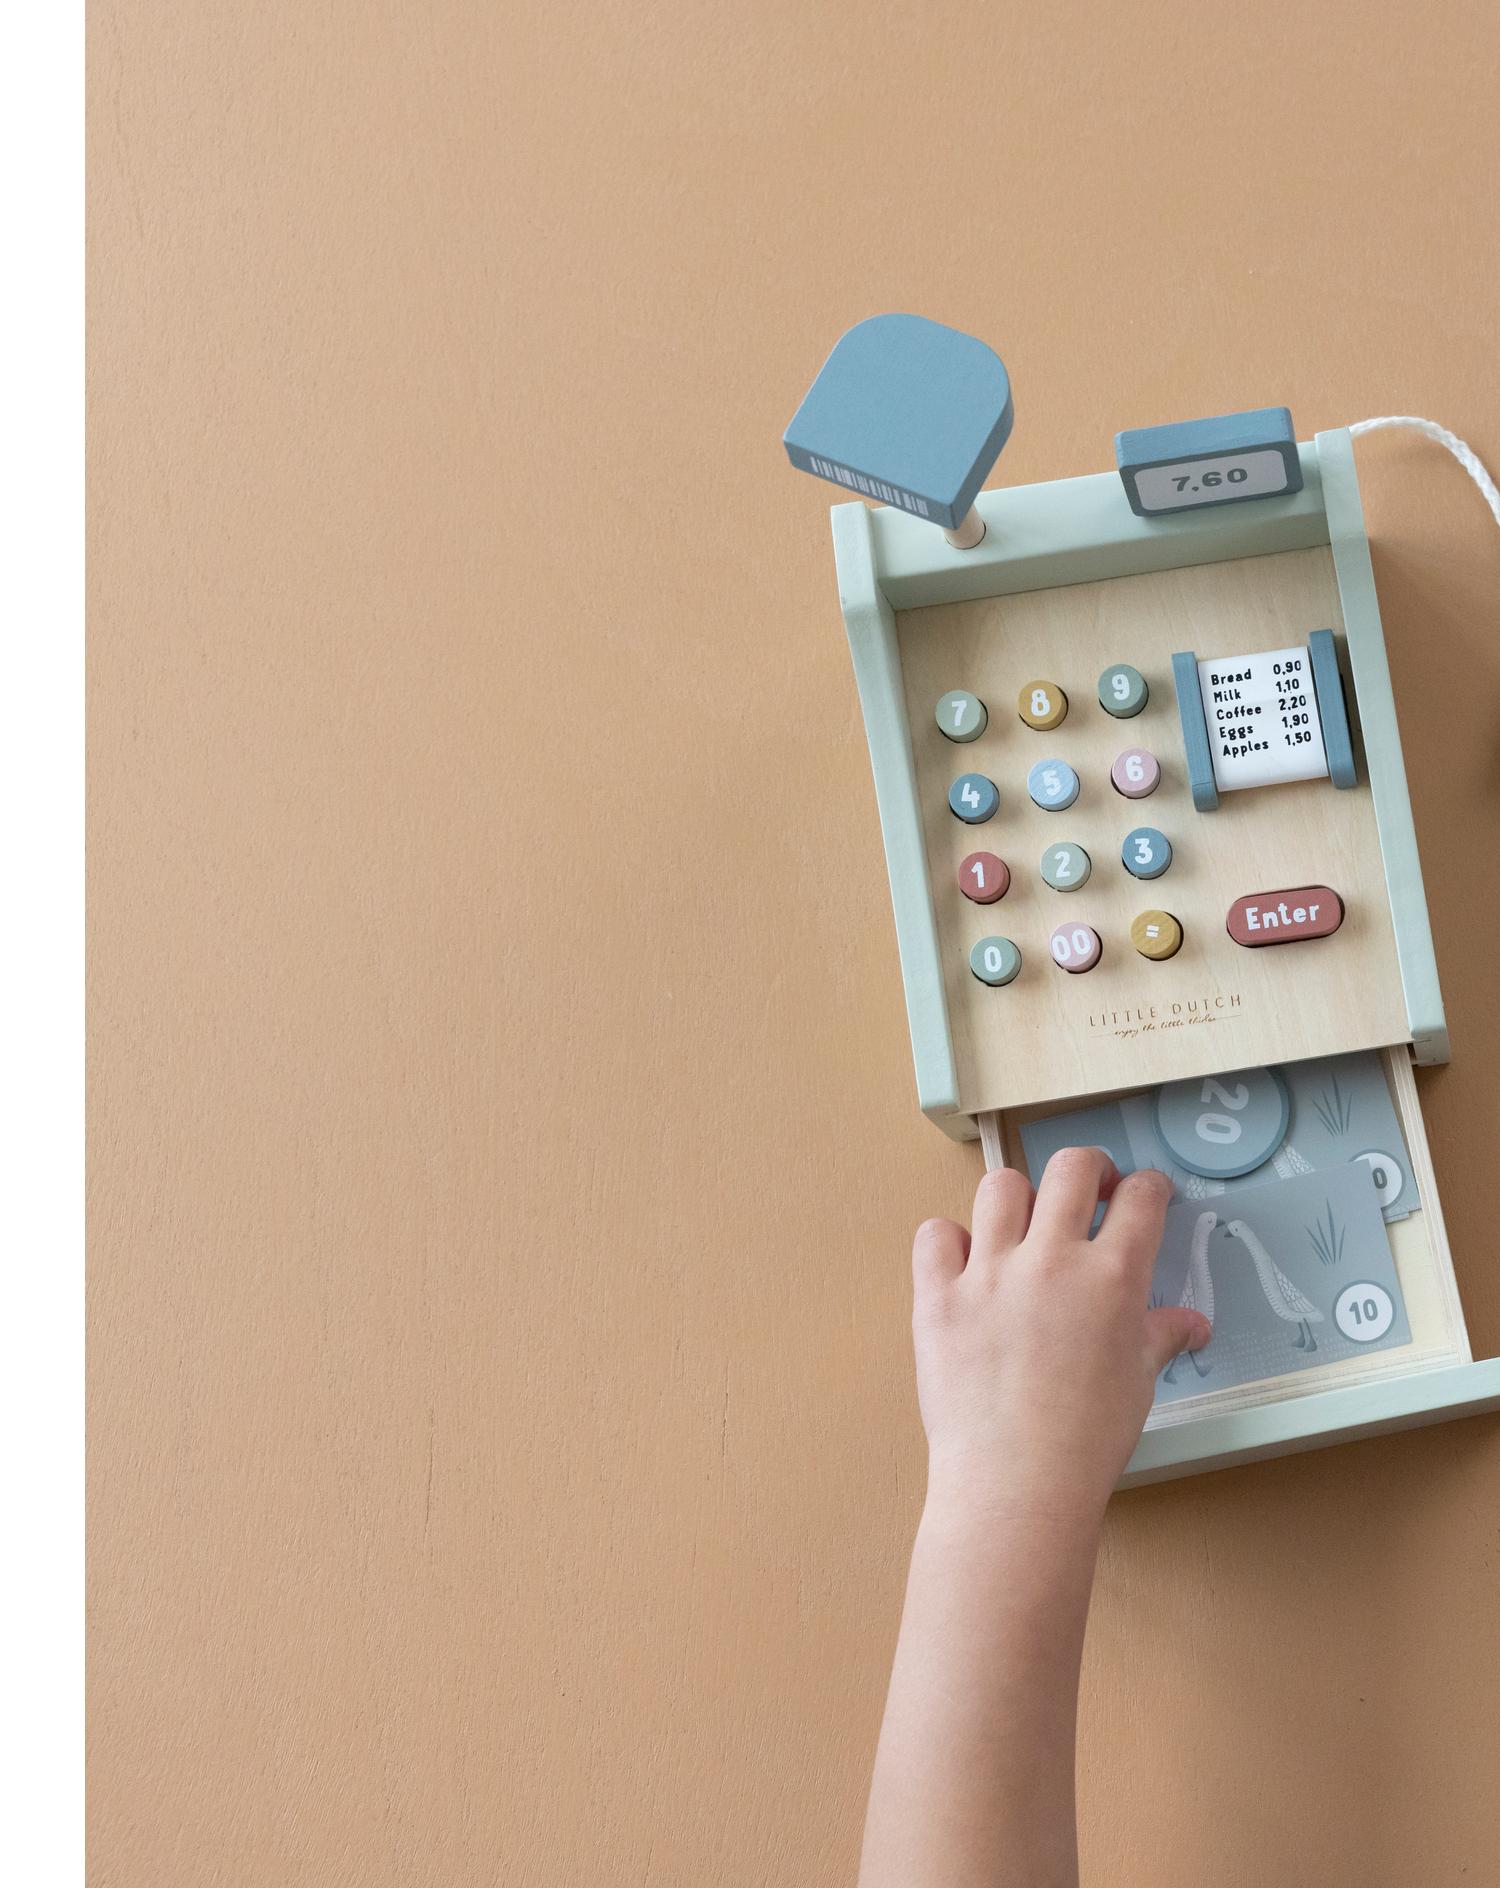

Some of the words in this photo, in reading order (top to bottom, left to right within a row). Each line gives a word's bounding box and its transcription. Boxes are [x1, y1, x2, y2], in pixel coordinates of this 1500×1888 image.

[1171, 468, 1248, 492] 7.60
[1211, 668, 1252, 686] Bread
[1273, 660, 1302, 676] 0,90
[1112, 674, 1131, 702] 9
[1213, 688, 1242, 703] Milk
[951, 700, 968, 727] 7
[1030, 688, 1050, 717] 8
[1216, 705, 1262, 720] Coffee
[1219, 725, 1254, 741] Eggs
[1222, 740, 1269, 758] Apples
[1125, 755, 1144, 782] 6
[961, 782, 981, 809] 4
[1041, 769, 1062, 796] 5
[1134, 837, 1154, 865] 3
[970, 861, 985, 889] 1
[1054, 851, 1071, 879] 2
[1245, 902, 1319, 931] Enter
[1051, 928, 1091, 962] 00
[983, 945, 1002, 973] 0
[1089, 1007, 1159, 1027] LITTLE
[1172, 994, 1242, 1016] DUTCH
[1195, 1078, 1250, 1144] 20
[1348, 1298, 1379, 1325] 10
